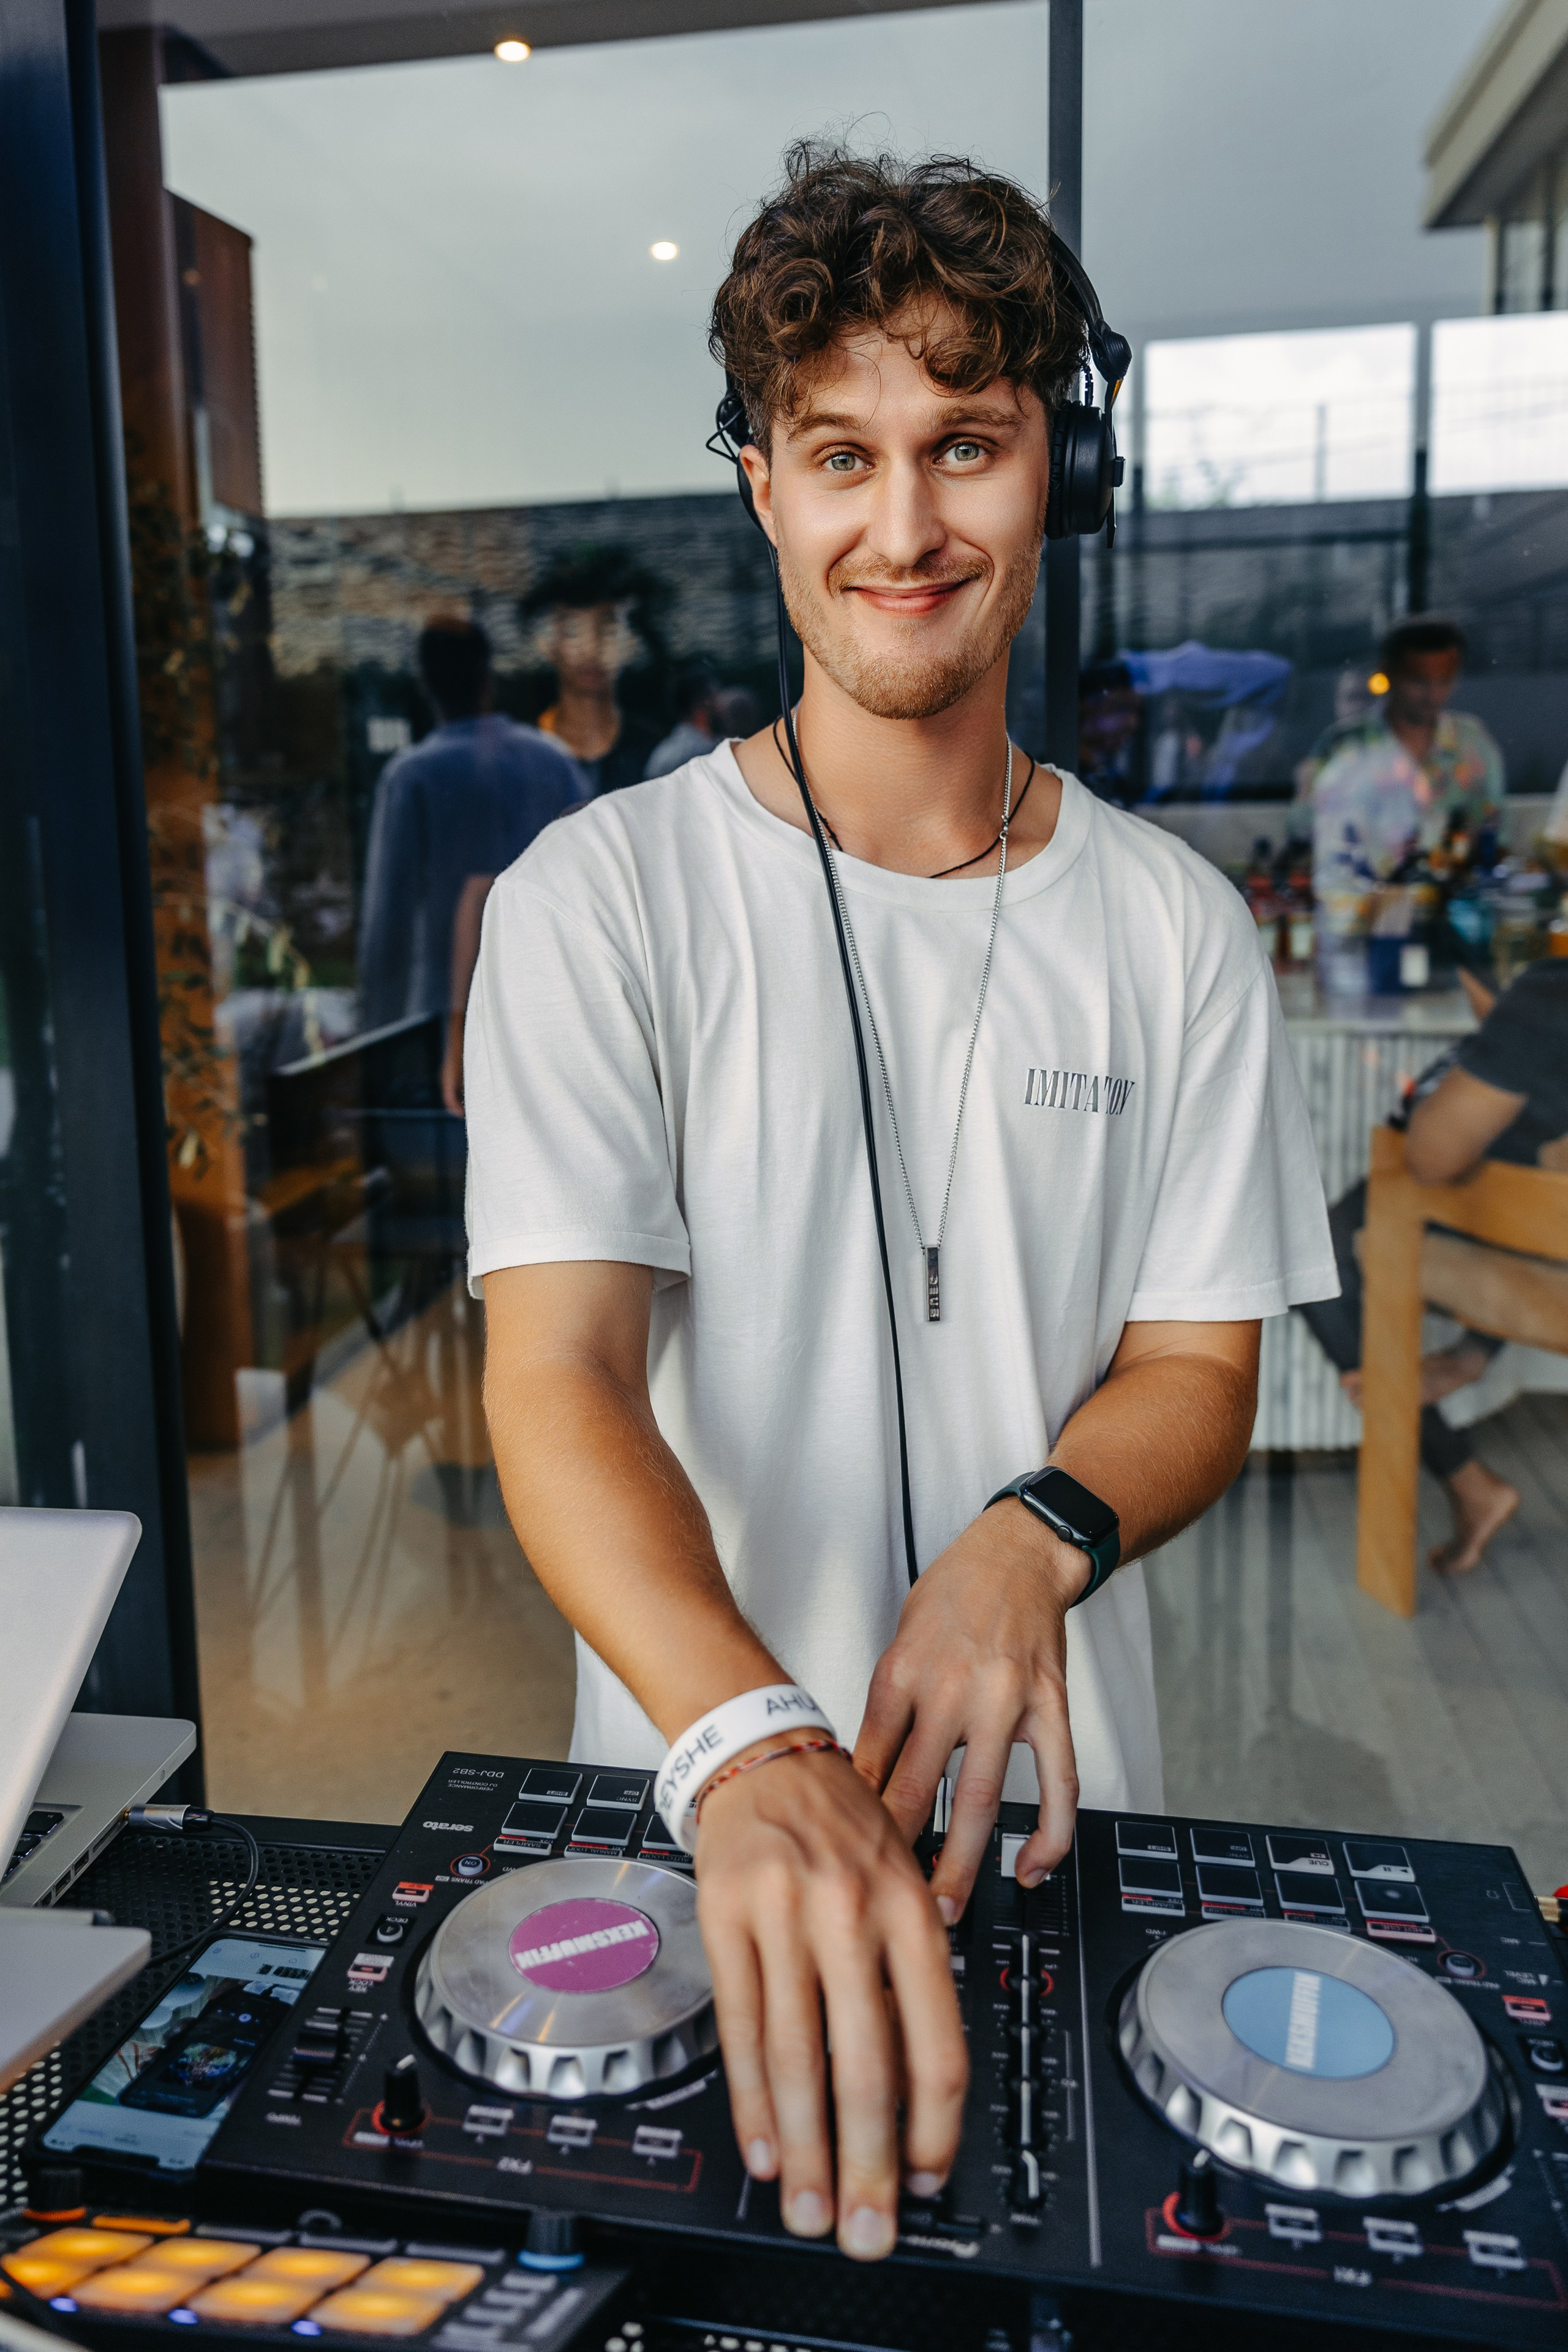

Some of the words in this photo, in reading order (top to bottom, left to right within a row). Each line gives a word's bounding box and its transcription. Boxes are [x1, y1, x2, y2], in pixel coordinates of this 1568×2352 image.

[453, 1767, 504, 1779] DDJ-SB2
[422, 1820, 474, 1834] serato
[503, 1839, 541, 1849] SAMPLER
